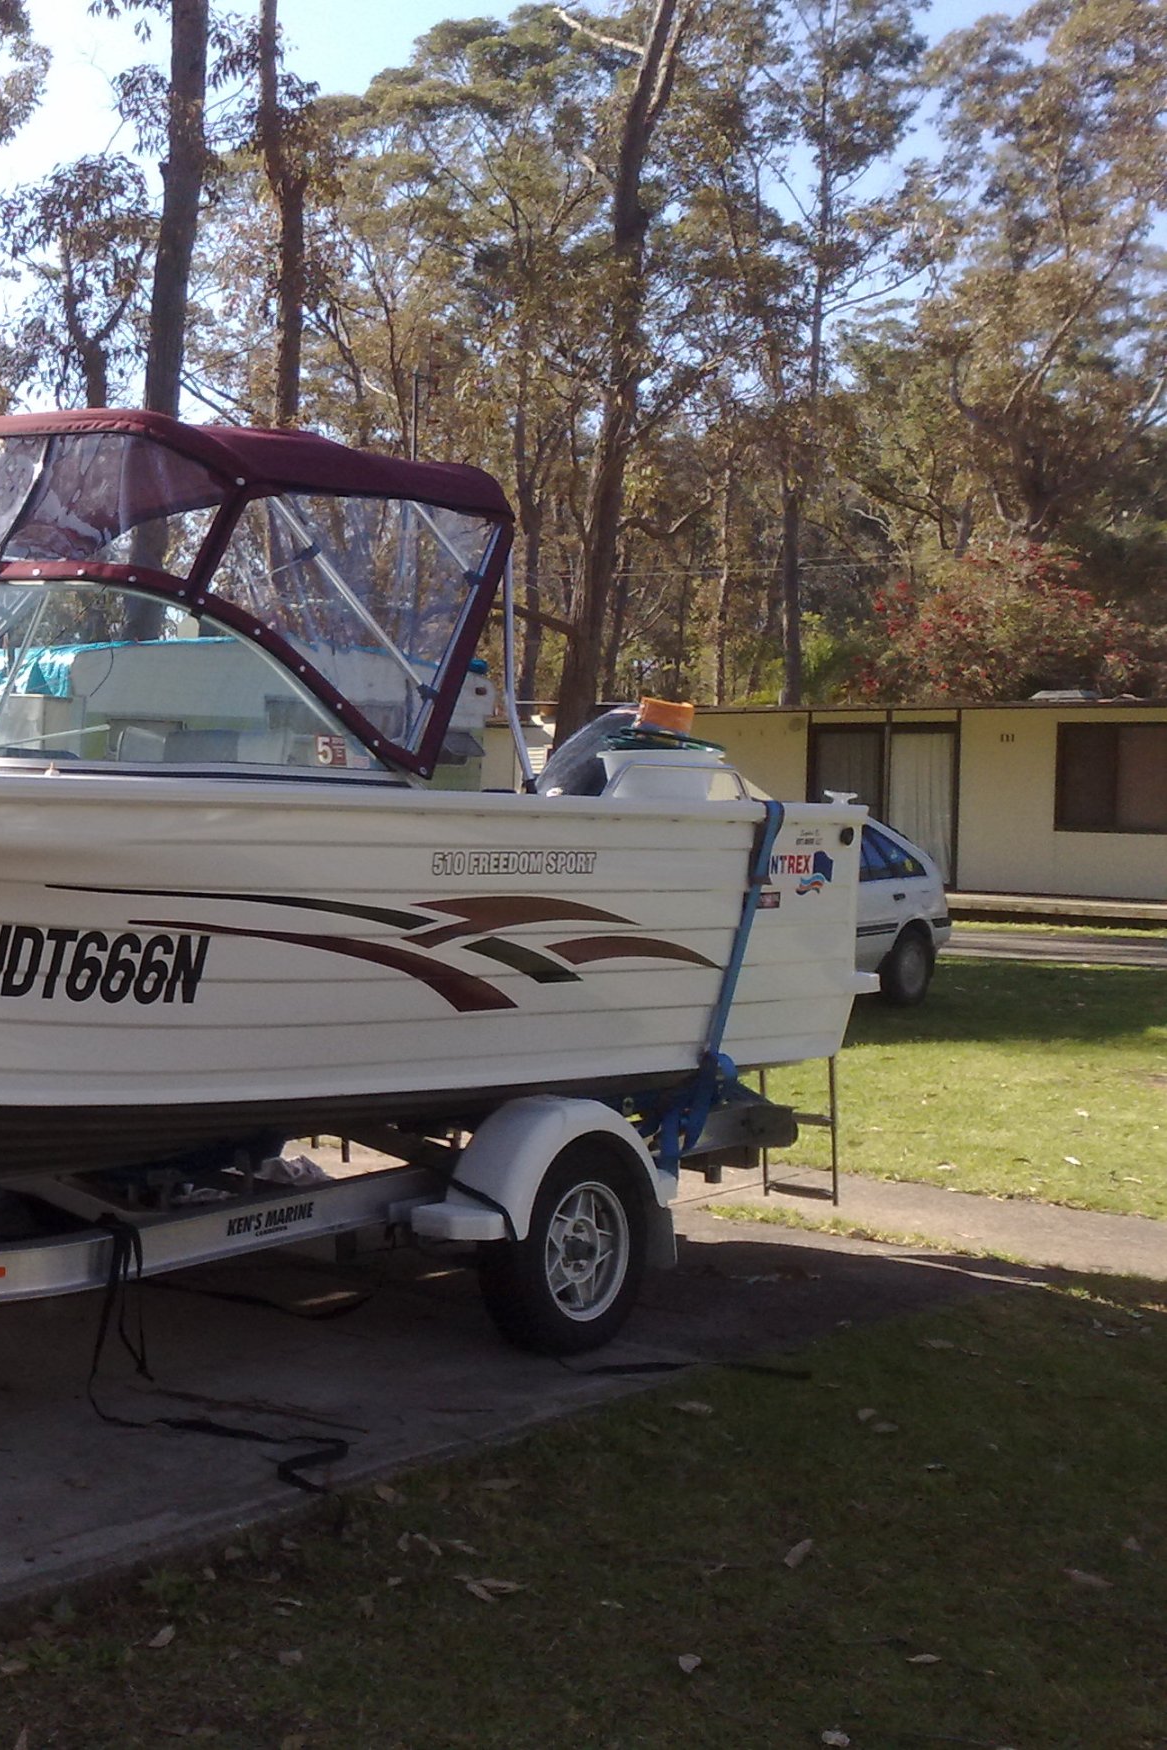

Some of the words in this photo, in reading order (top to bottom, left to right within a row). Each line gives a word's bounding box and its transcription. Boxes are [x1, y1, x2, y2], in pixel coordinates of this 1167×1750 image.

[432, 852, 465, 875] 510
[467, 852, 544, 875] FREEDOM
[545, 852, 596, 875] SPORT
[770, 855, 812, 875] NTREX
[226, 1213, 263, 1236] KEN'S
[264, 1202, 314, 1228] MARINE
